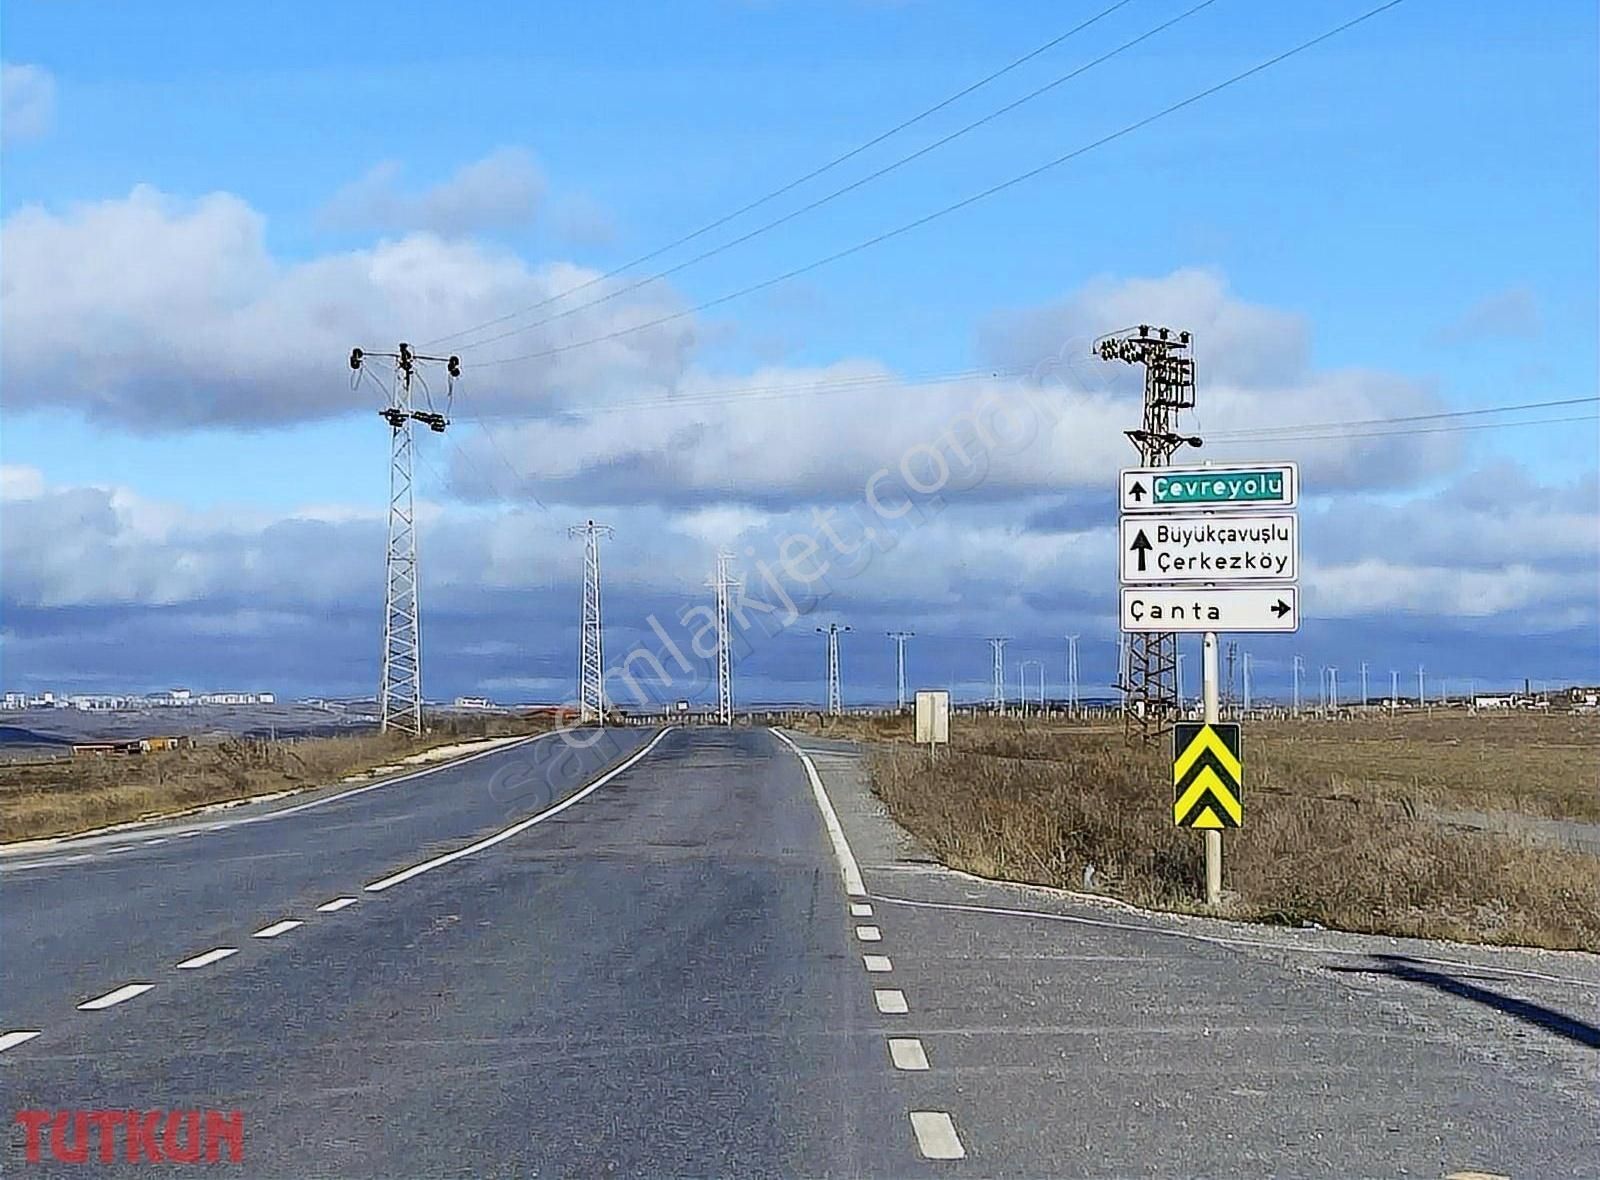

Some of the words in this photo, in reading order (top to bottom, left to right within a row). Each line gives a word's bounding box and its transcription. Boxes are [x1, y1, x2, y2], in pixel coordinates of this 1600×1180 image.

[1153, 474, 1282, 500] Çevreyolu
[1157, 523, 1289, 547] Büyükçavuşlu
[1157, 551, 1288, 573] Çerkezköy
[1130, 600, 1220, 621] Çanta
